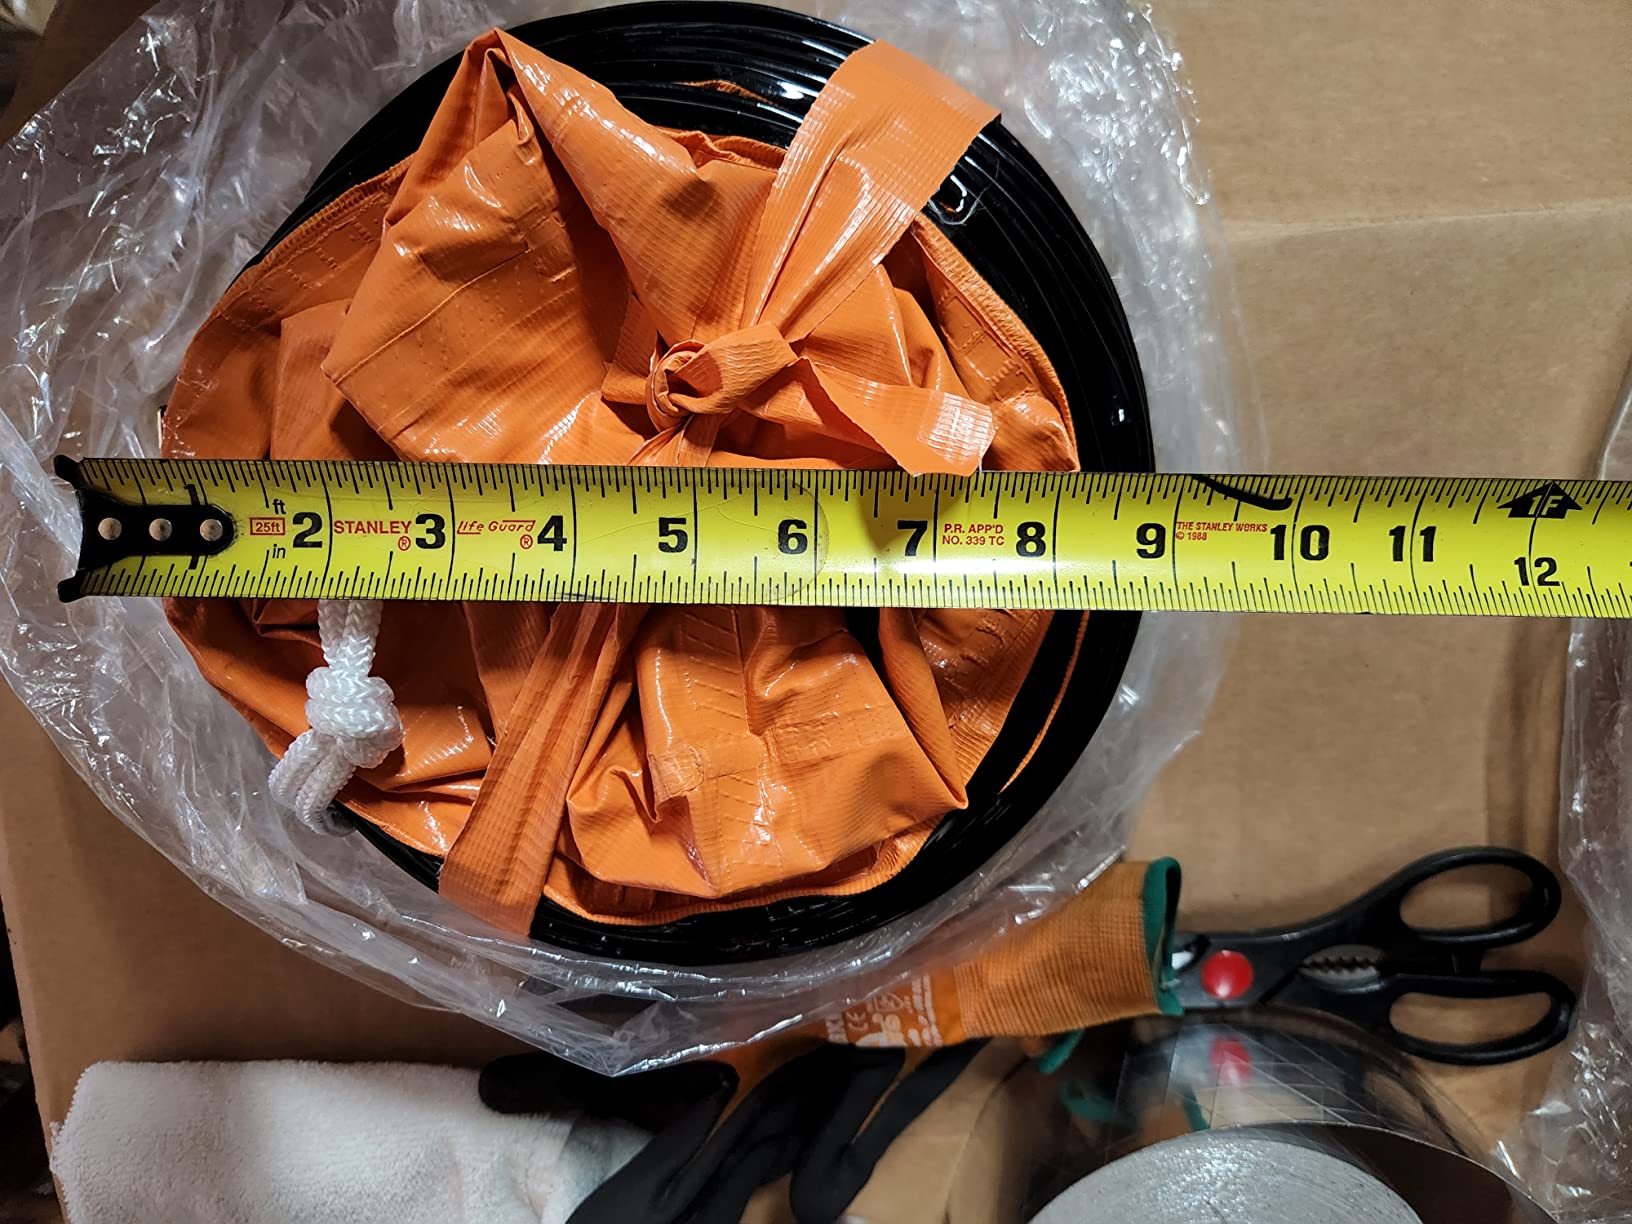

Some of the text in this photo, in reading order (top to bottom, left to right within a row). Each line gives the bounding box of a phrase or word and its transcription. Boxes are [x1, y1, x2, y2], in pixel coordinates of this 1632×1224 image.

[272, 498, 286, 515] ft
[254, 521, 281, 533] 25ft
[292, 511, 323, 549] 2
[333, 520, 412, 534] STANLEY
[415, 513, 446, 550] 3
[456, 519, 537, 535] Life Guard
[537, 514, 568, 552] 4
[657, 516, 689, 553] 5
[777, 518, 808, 555] 6
[897, 520, 929, 557] 7
[942, 535, 1005, 546] NO. 339 TC
[943, 523, 1004, 534] P.R. APP'D
[1015, 521, 1047, 558] 8
[1136, 522, 1167, 559] 9
[1177, 521, 1268, 533] THE STANLEY WORKS
[1187, 531, 1208, 541] 1988
[1269, 524, 1330, 561] 10
[1388, 525, 1437, 562] 11
[272, 543, 286, 559] in
[1513, 556, 1560, 587] 12
